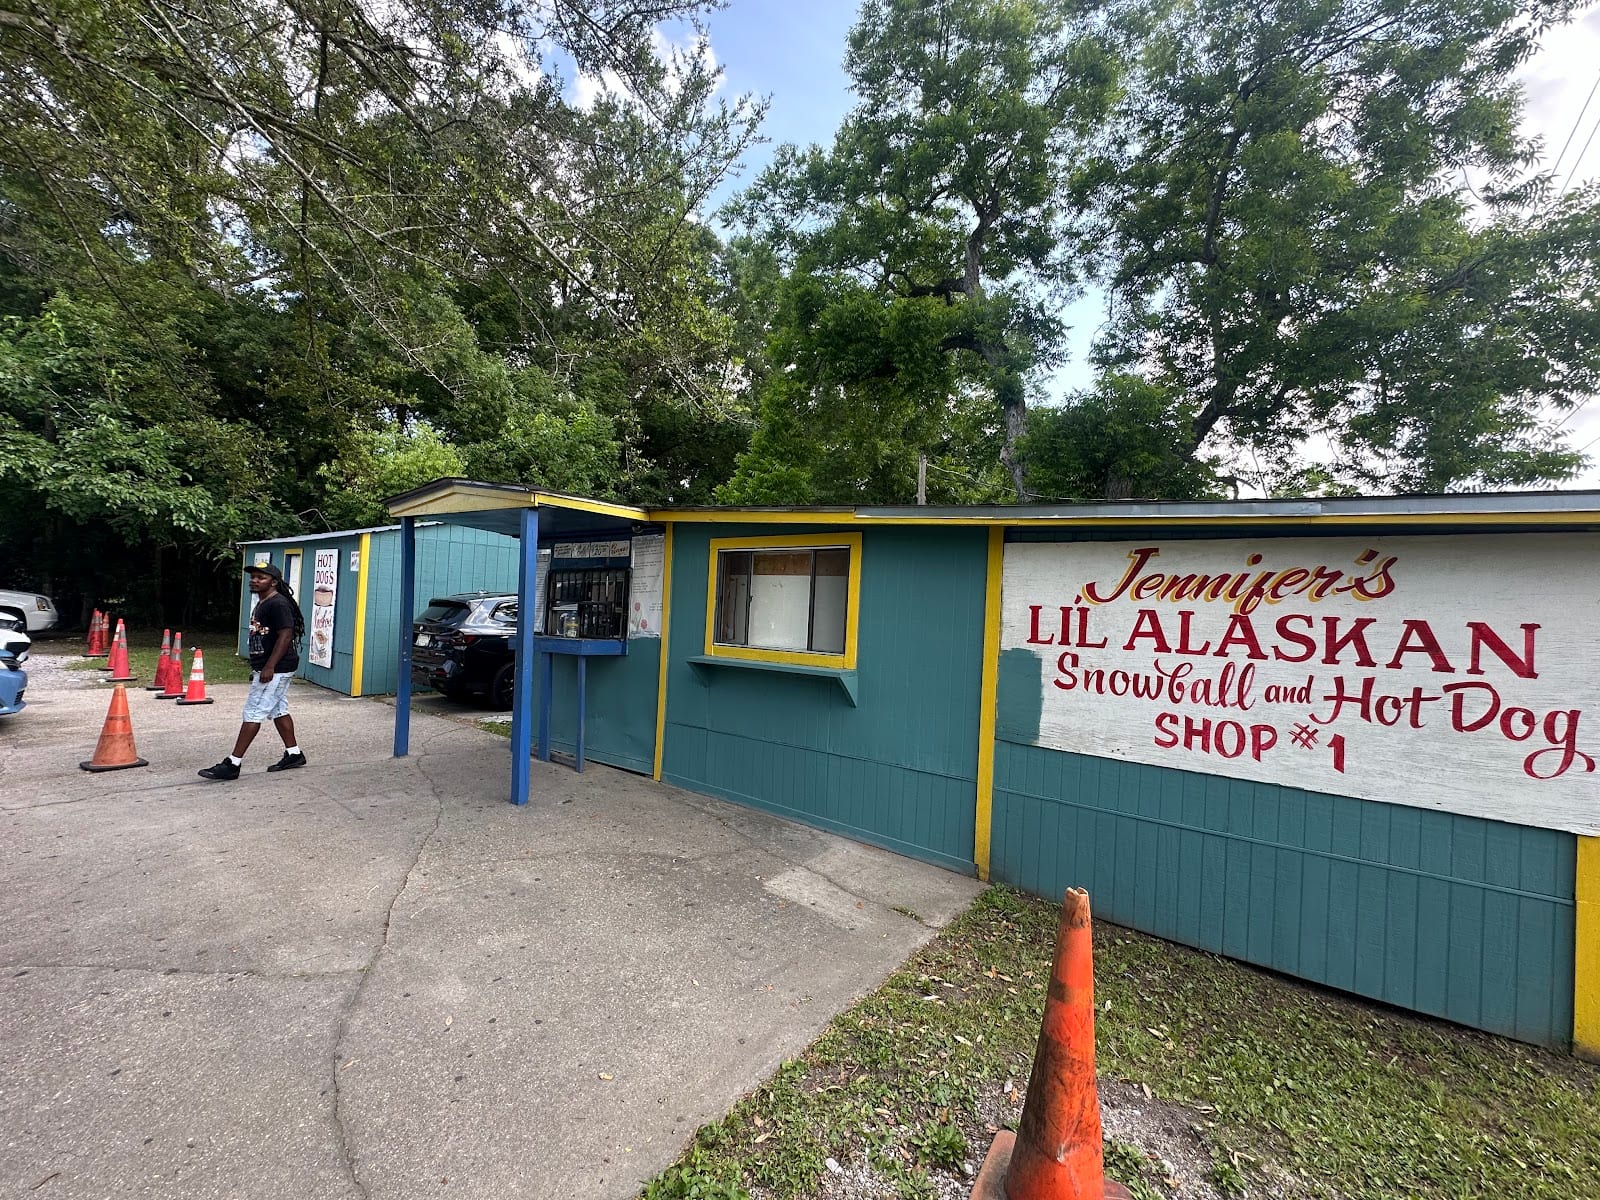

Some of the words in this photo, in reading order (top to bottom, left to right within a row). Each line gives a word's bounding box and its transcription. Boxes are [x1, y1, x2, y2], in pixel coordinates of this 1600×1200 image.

[317, 554, 333, 568] HOT
[1081, 547, 1398, 616] Jennifer's
[1122, 608, 1542, 680] ALASKAN
[1053, 651, 1256, 711] Snowball
[1264, 674, 1315, 705] and
[1308, 675, 1442, 730] Hot
[1442, 681, 1596, 780] Dog
[1154, 711, 1278, 763] SHOP
